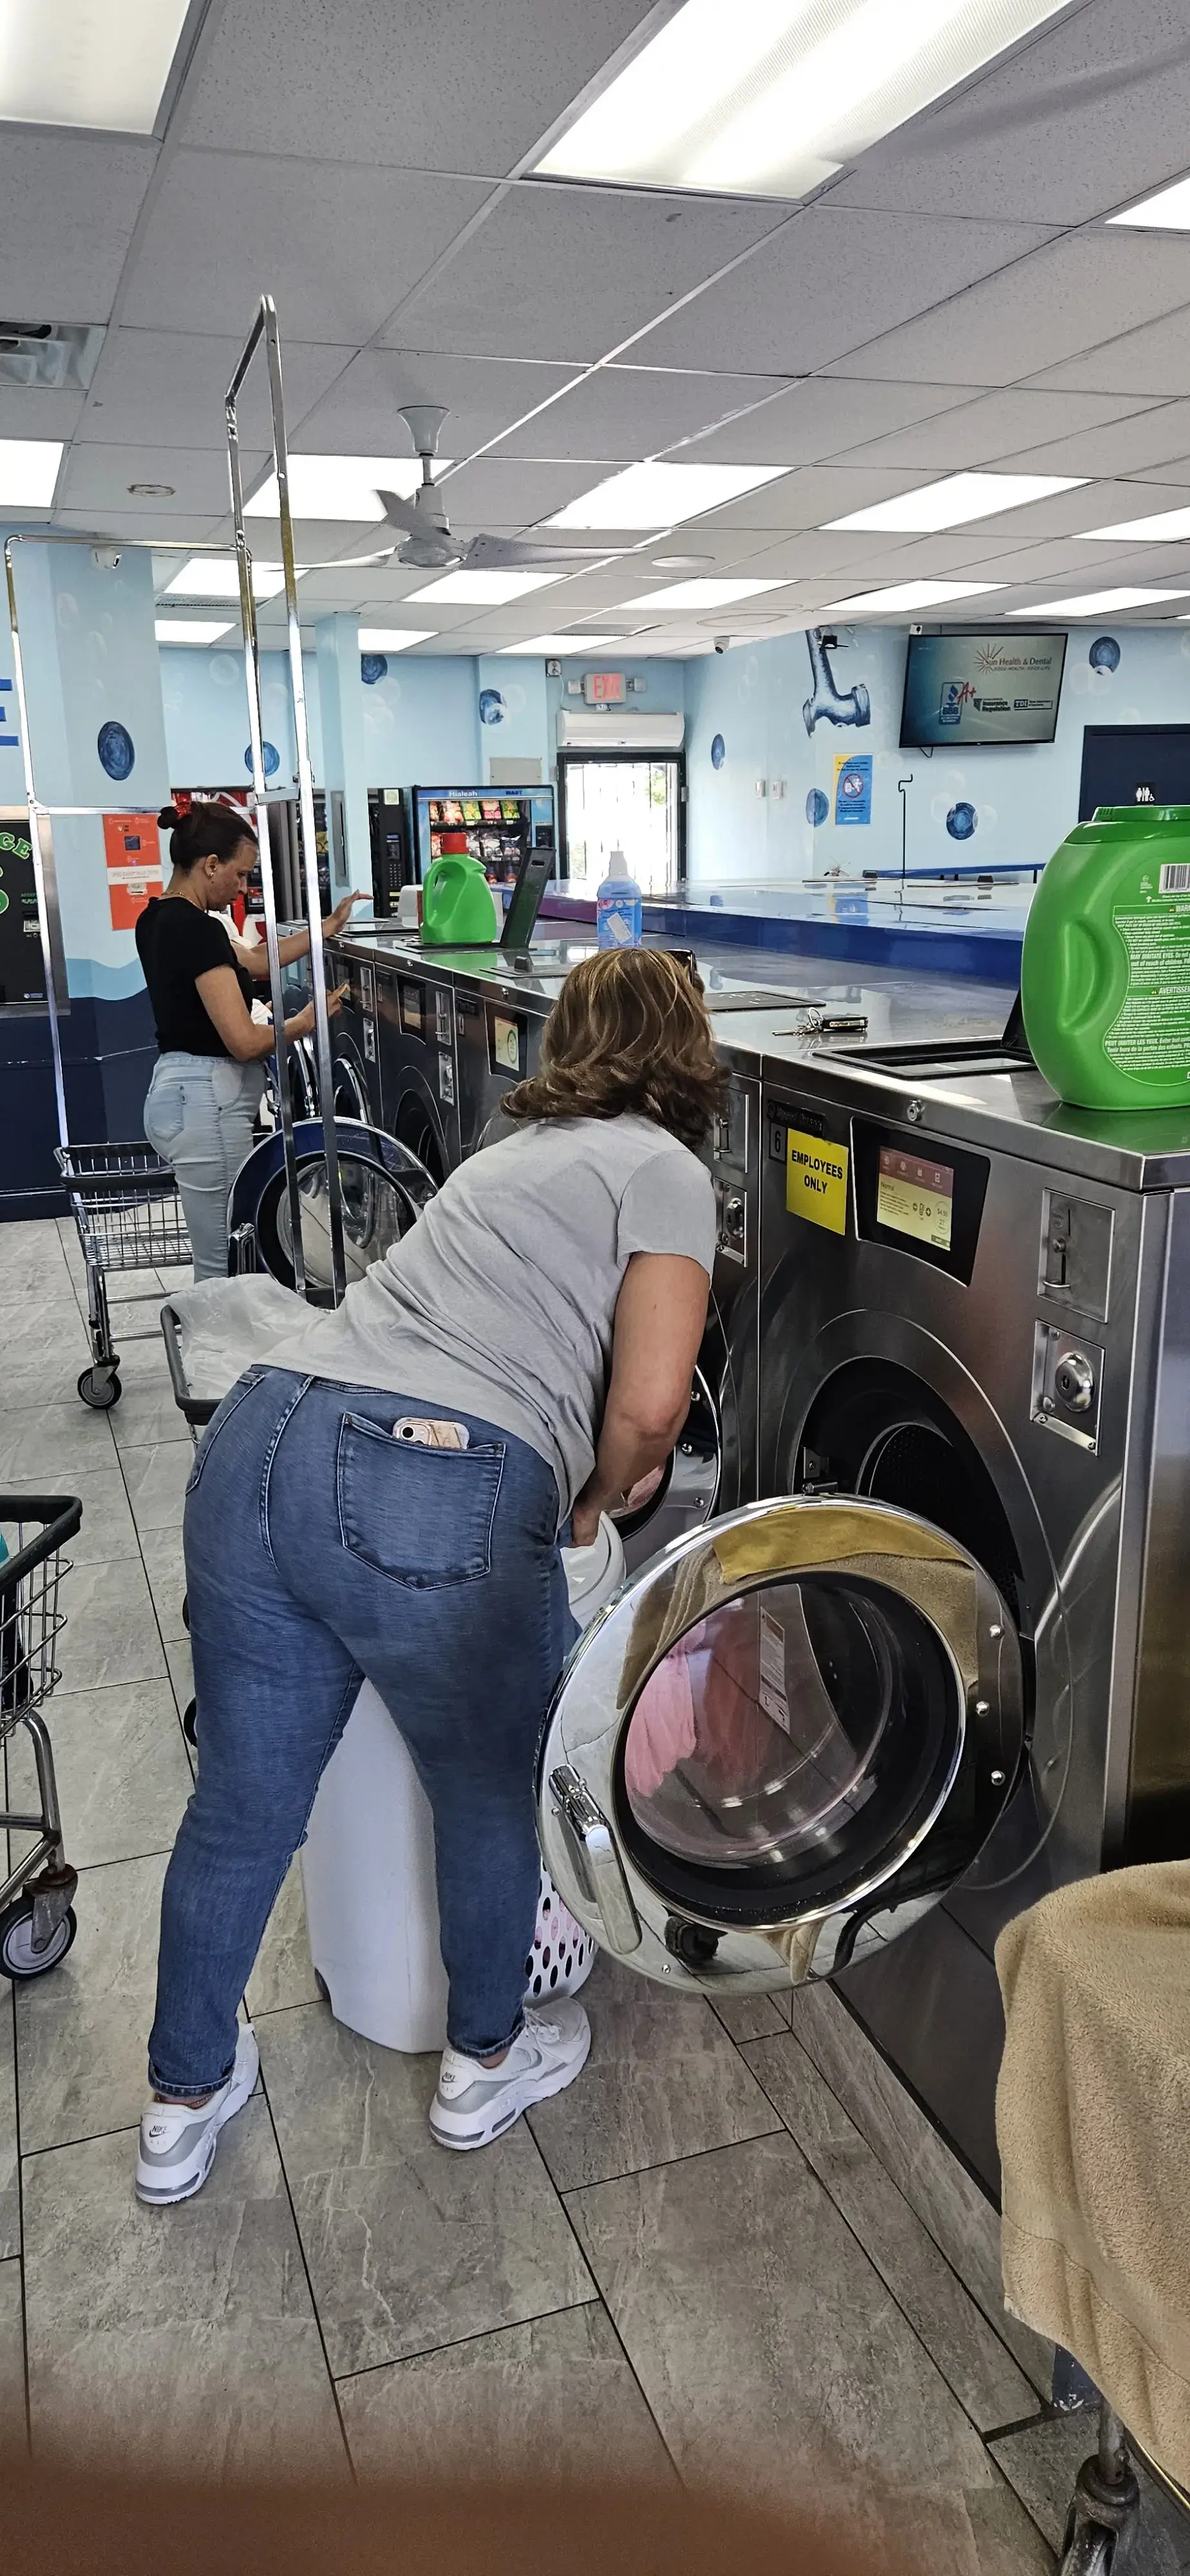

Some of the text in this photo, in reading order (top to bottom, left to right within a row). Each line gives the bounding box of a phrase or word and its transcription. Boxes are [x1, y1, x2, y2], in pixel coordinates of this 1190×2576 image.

[594, 674, 620, 699] EXIT
[775, 1130, 782, 1153] 6
[791, 1150, 843, 1179] EMPLOYEES
[804, 1175, 828, 1194] ONLY
[445, 2071, 456, 2081] NIKE
